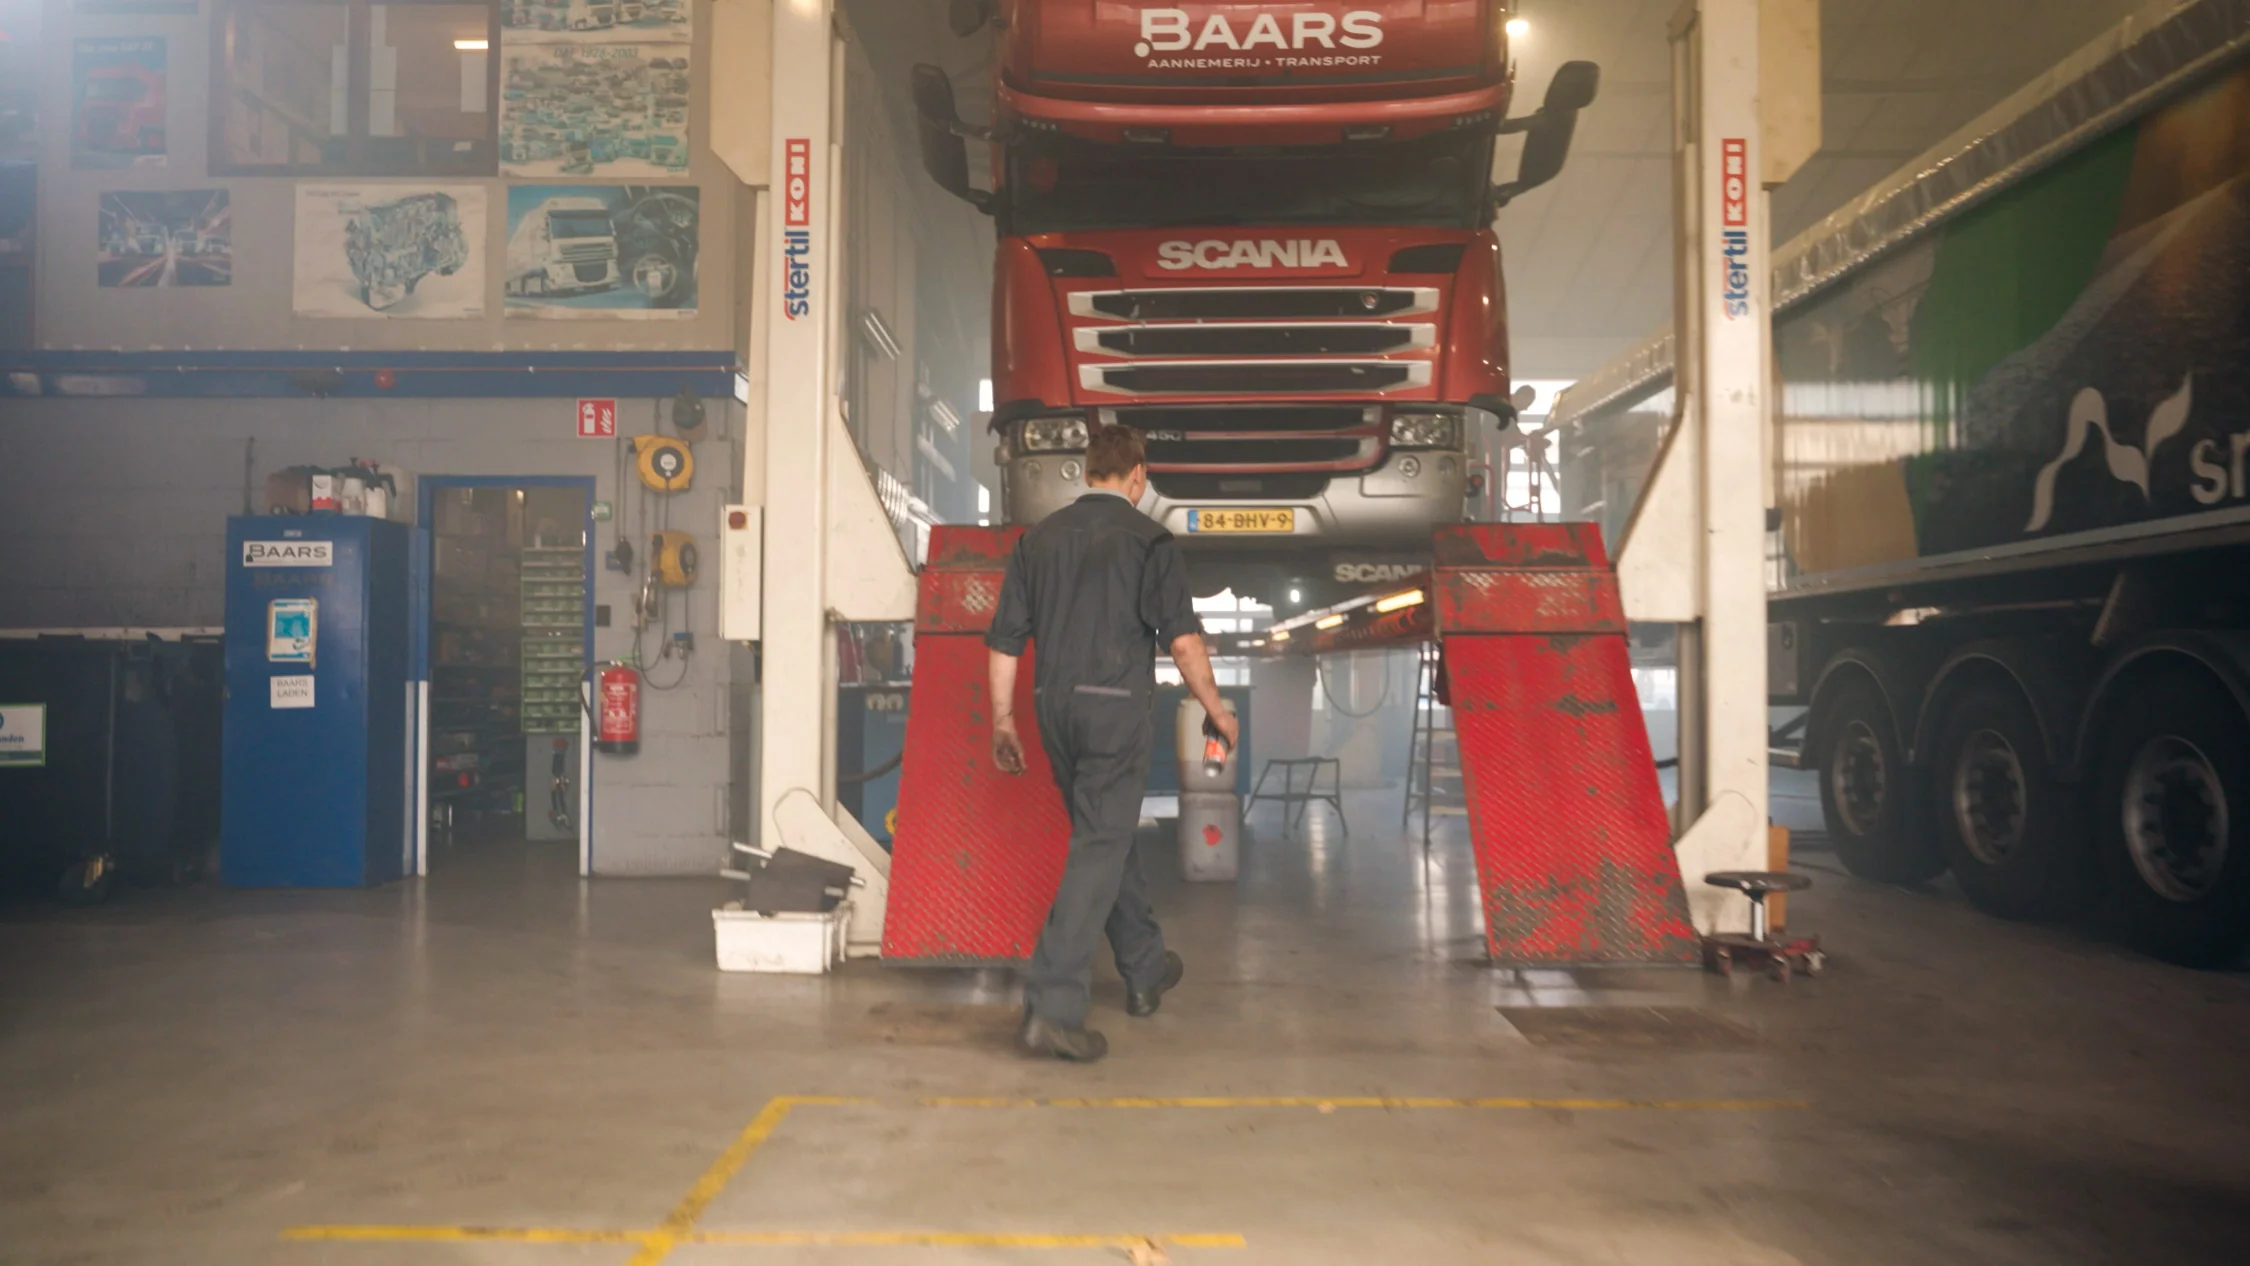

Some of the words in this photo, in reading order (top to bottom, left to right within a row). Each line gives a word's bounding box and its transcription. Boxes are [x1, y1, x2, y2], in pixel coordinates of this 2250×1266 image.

[1134, 8, 1384, 57] BAARS
[1148, 58, 1260, 68] AANNEMERIJ
[1275, 55, 1382, 67] TRANSPORT
[789, 143, 806, 222] KONI
[1726, 143, 1743, 222] KONI
[1157, 239, 1349, 270] SCANIA
[784, 231, 810, 321] stertil
[1722, 231, 1748, 321] stertil
[1203, 512, 1289, 529] 84-BHV-9
[246, 543, 328, 560] BAARS
[276, 688, 309, 699] LADEN
